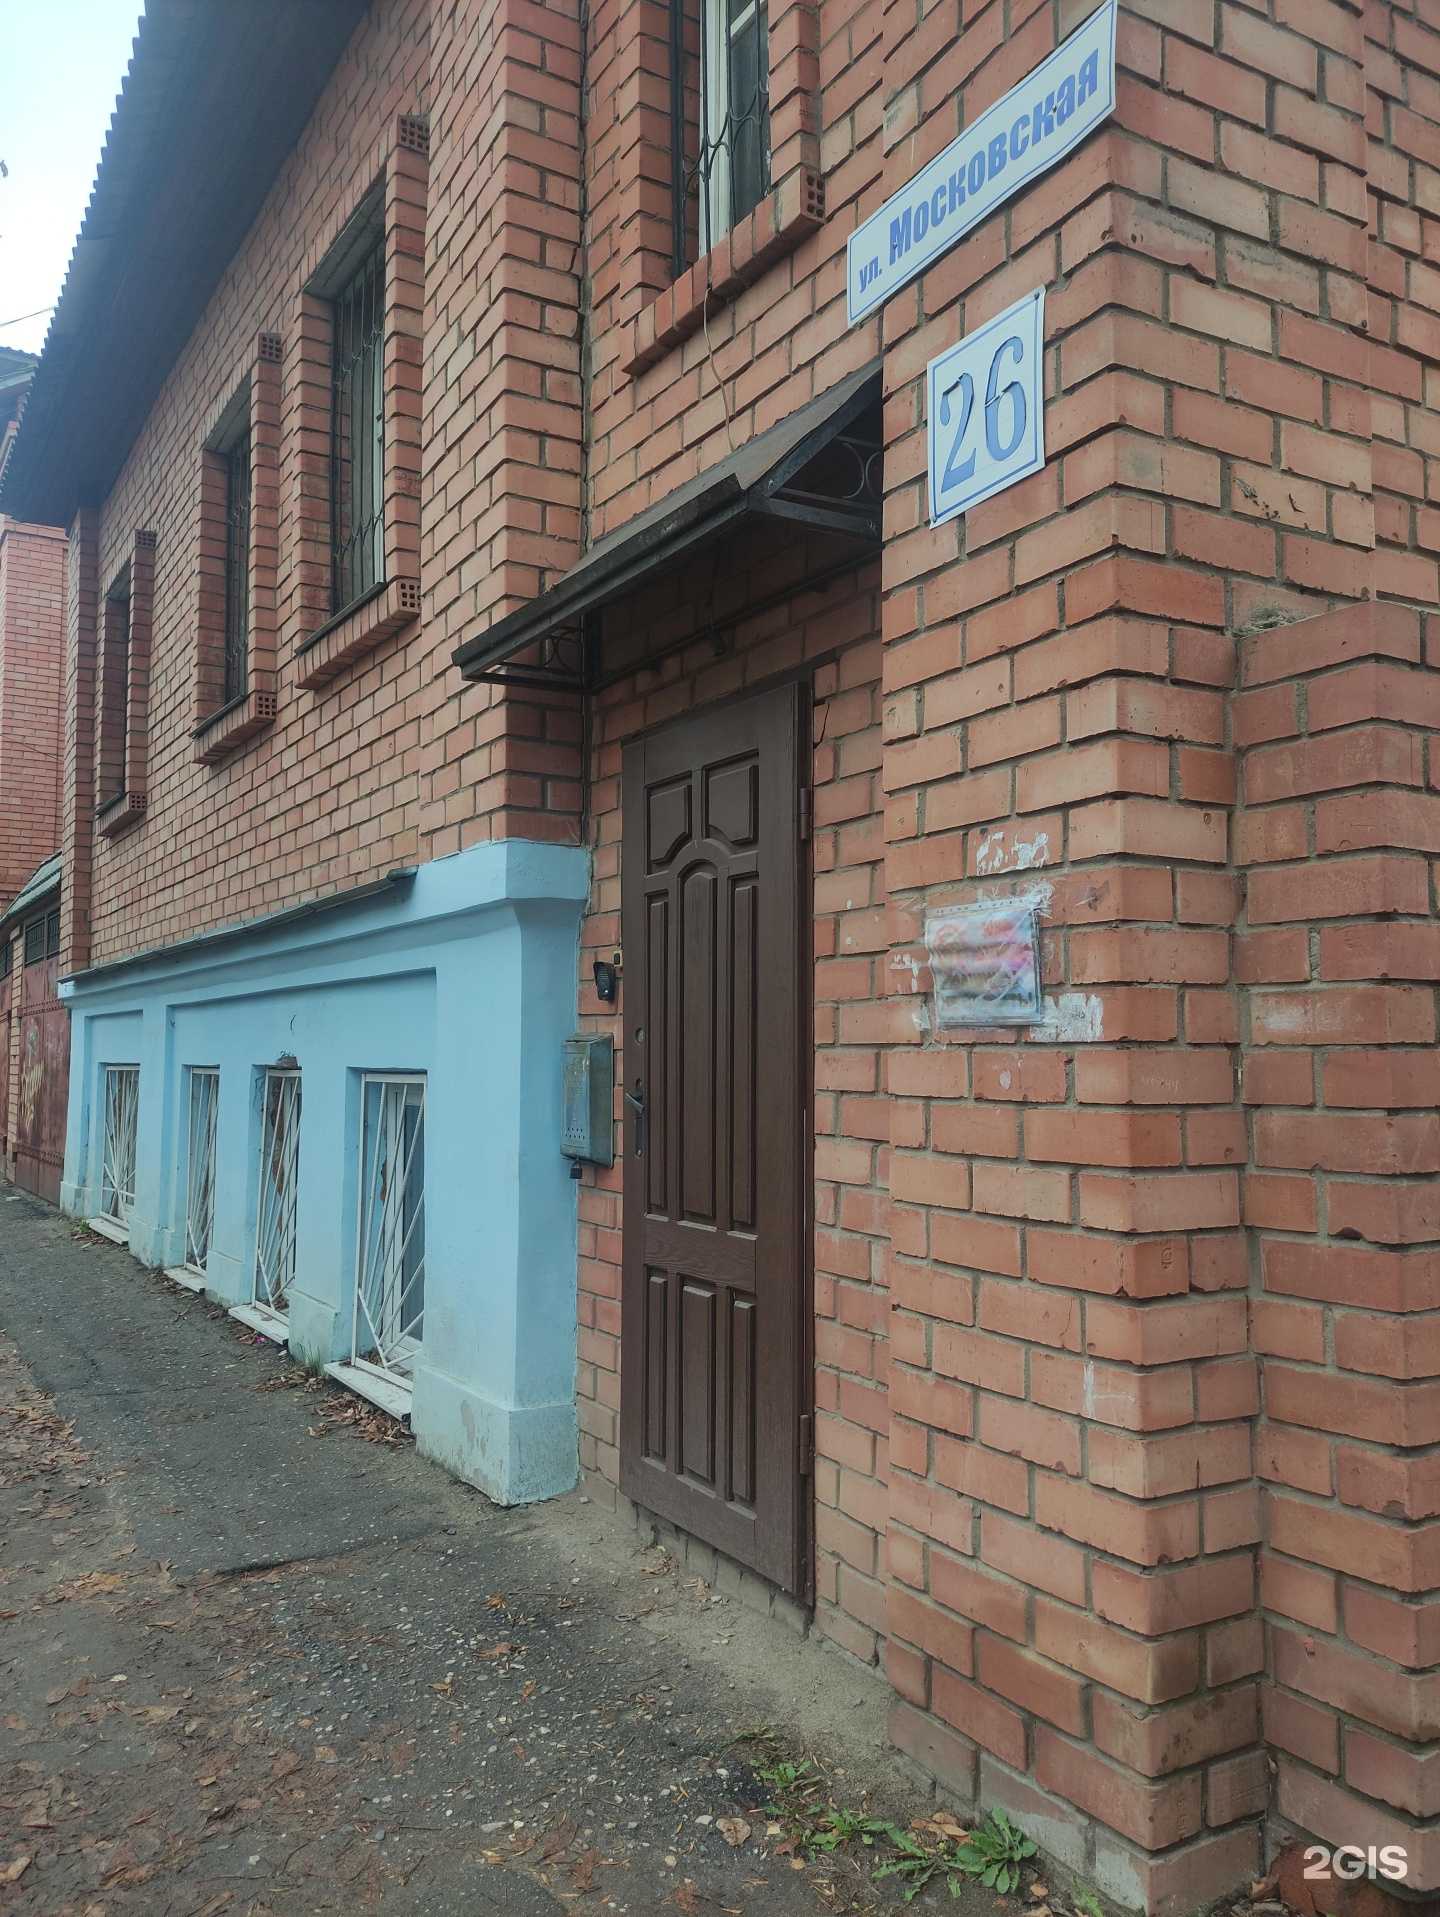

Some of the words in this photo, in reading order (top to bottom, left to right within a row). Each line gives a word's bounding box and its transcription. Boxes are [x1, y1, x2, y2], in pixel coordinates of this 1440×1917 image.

[859, 255, 883, 293] ул.
[889, 48, 1099, 266] Московская
[940, 336, 1026, 493] 26
